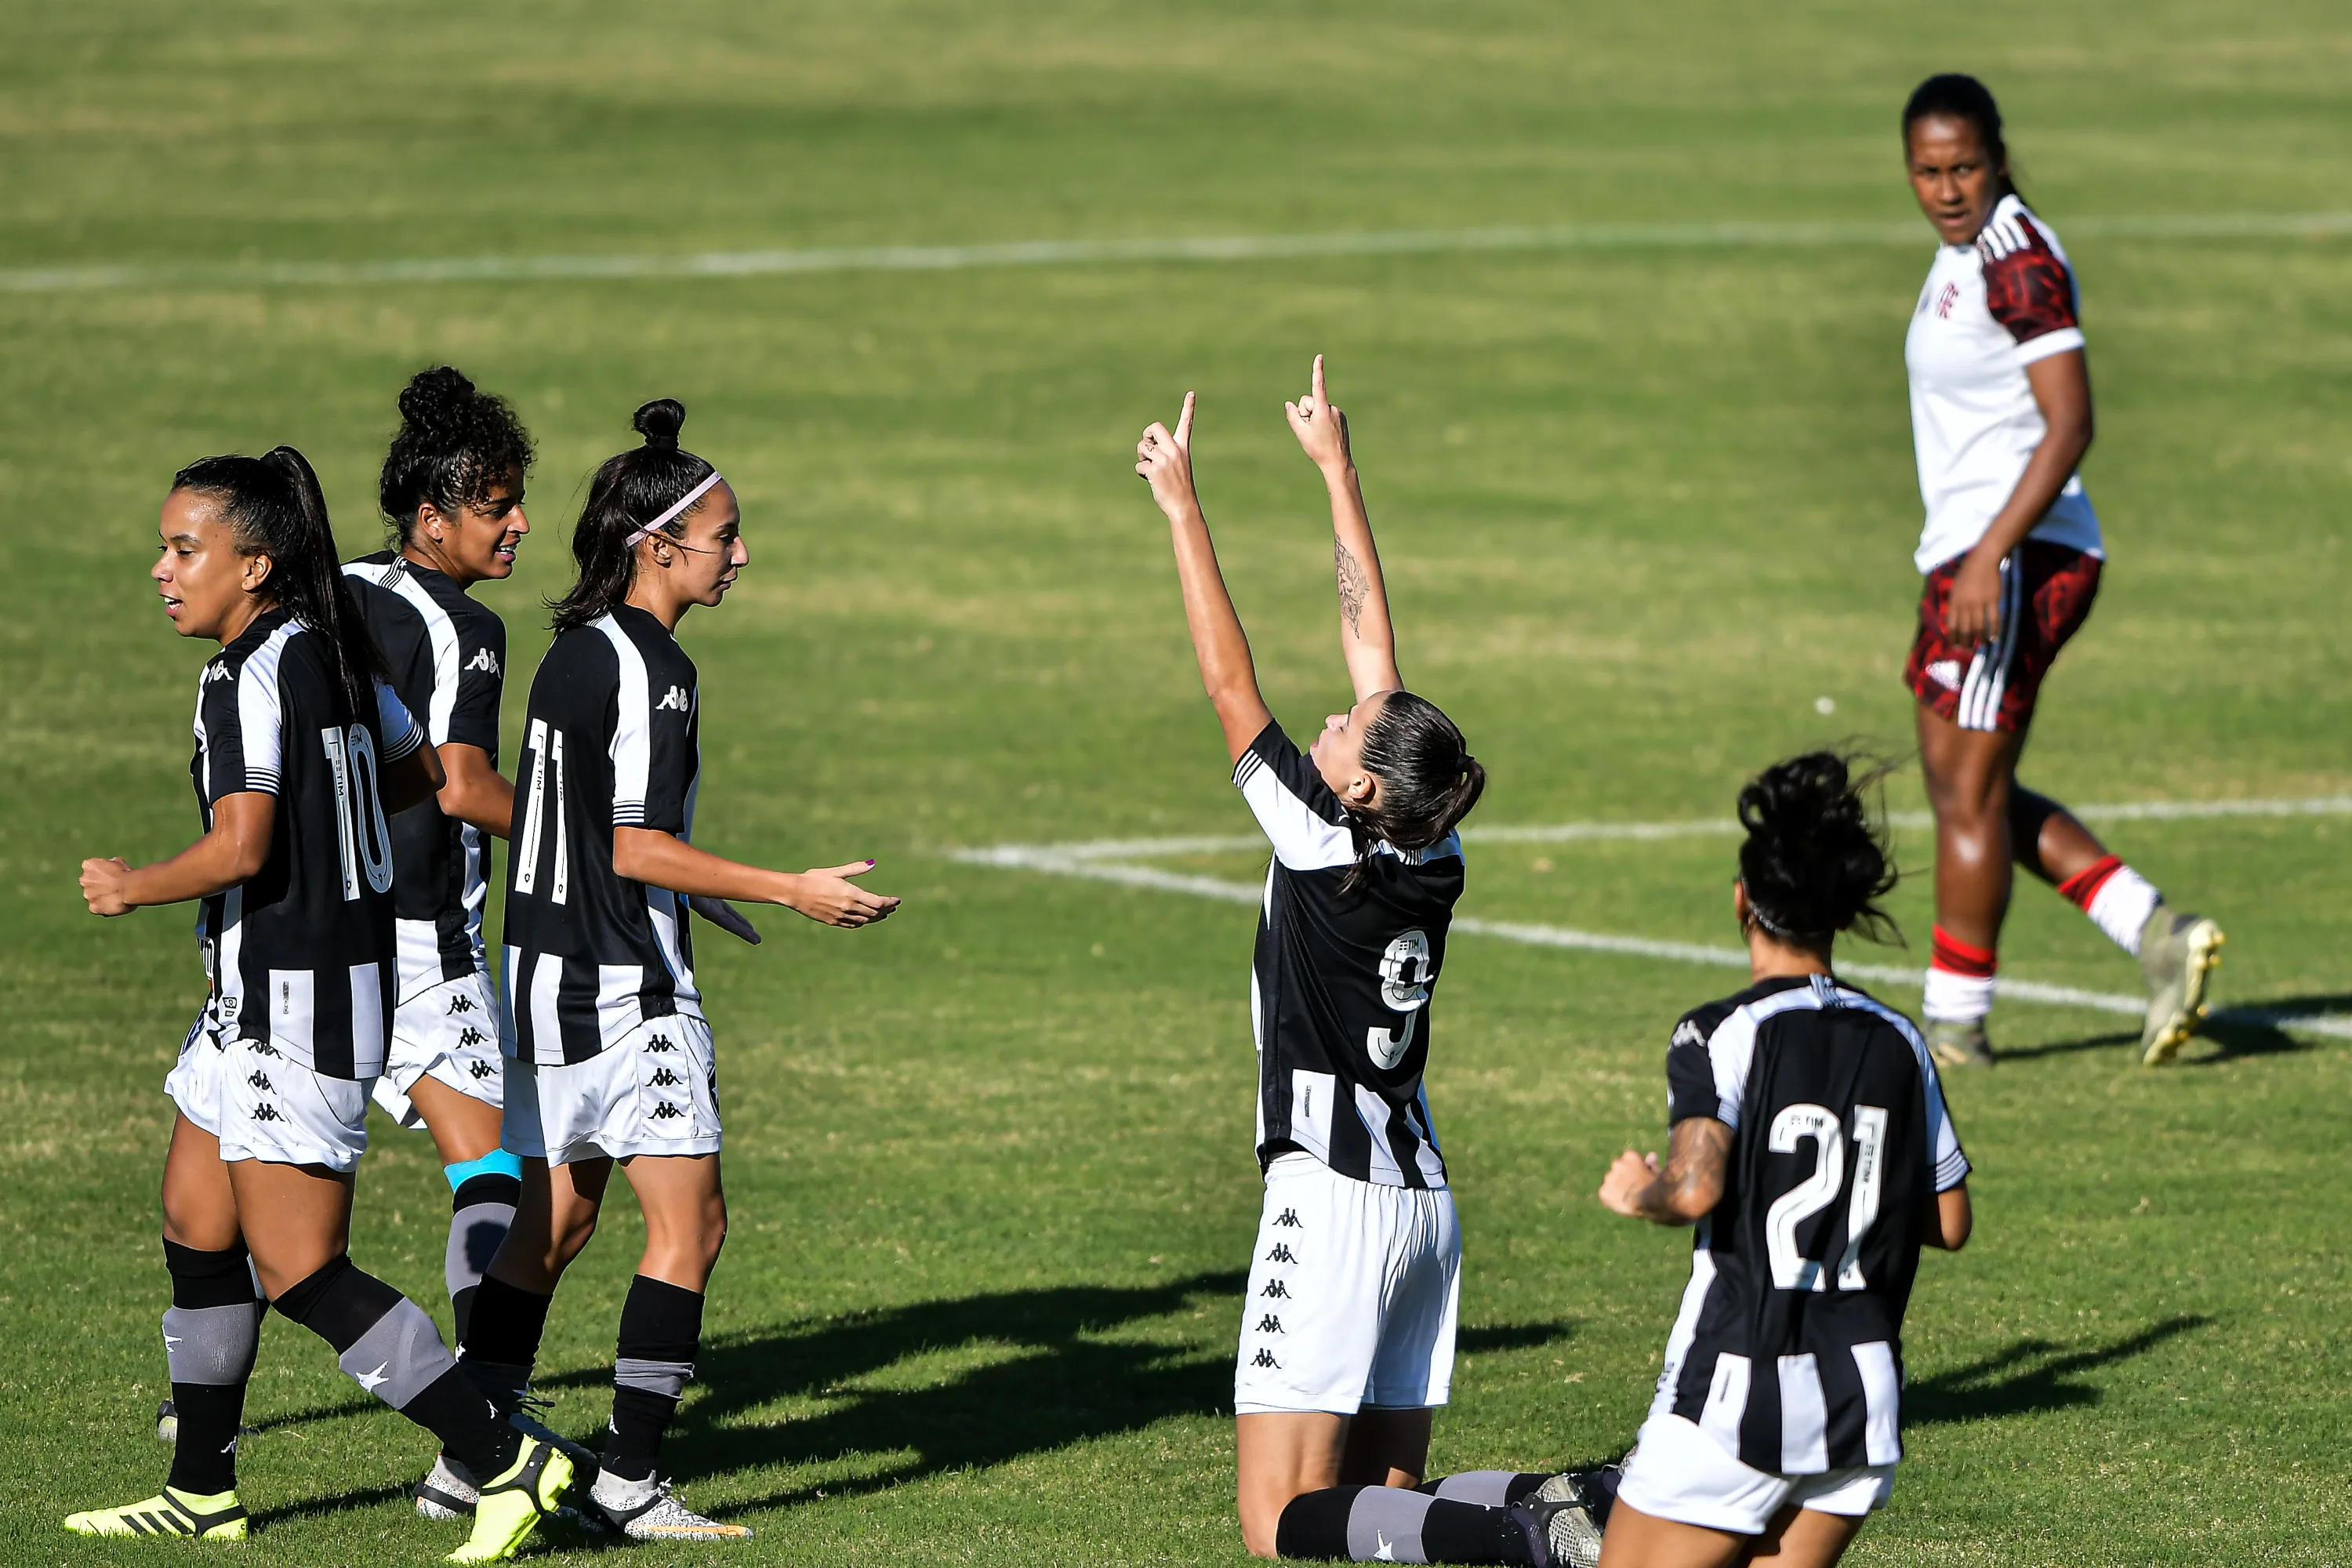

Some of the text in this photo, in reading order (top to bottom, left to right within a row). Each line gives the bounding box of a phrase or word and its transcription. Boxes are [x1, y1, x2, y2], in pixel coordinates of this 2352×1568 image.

[321, 723, 393, 901] 10
[515, 717, 568, 905] 11
[1367, 931, 1434, 1069] 9
[1408, 938, 1420, 950] TIM
[1766, 1102, 1889, 1292] 21
[1806, 1116, 1824, 1130] TIM
